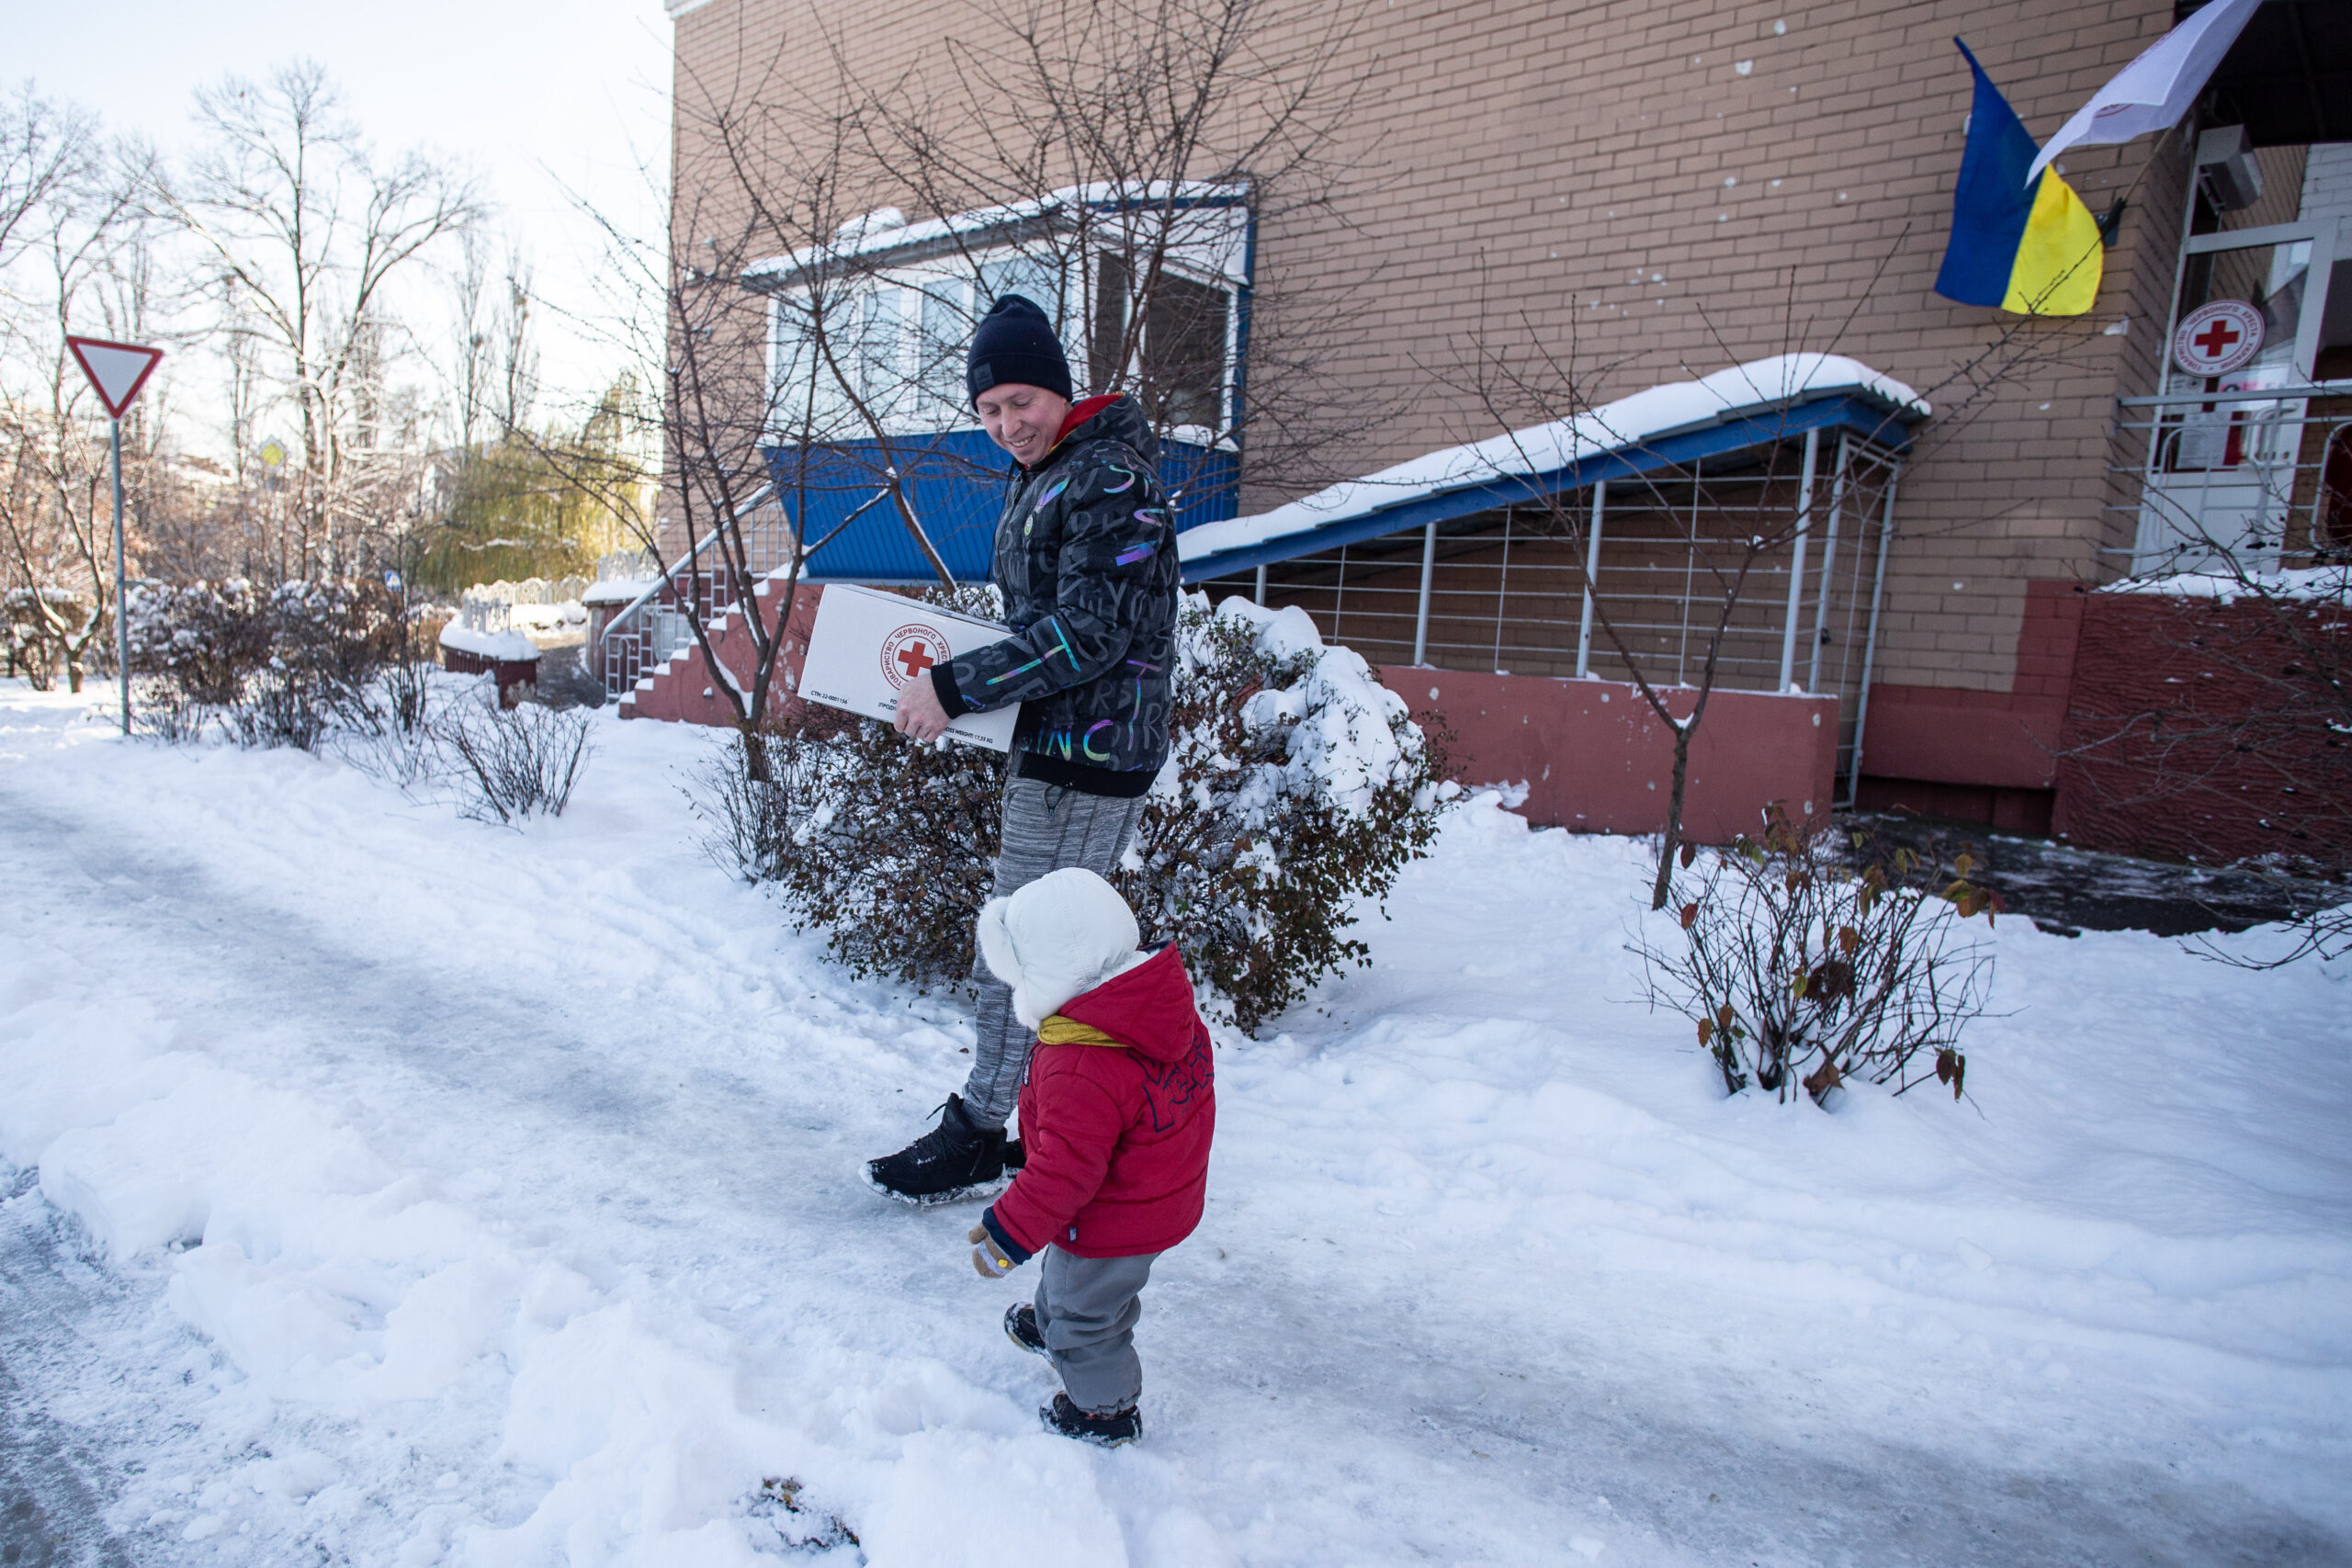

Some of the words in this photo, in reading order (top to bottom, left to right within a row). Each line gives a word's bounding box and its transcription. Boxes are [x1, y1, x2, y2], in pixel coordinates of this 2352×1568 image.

[884, 641, 902, 687] ТОВАРИСТВО
[894, 626, 936, 640] ЧЕРВОНОГО
[936, 640, 948, 663] ХРЕСТ
[810, 690, 821, 698] CTN:
[877, 701, 897, 711] (ПРОДУ
